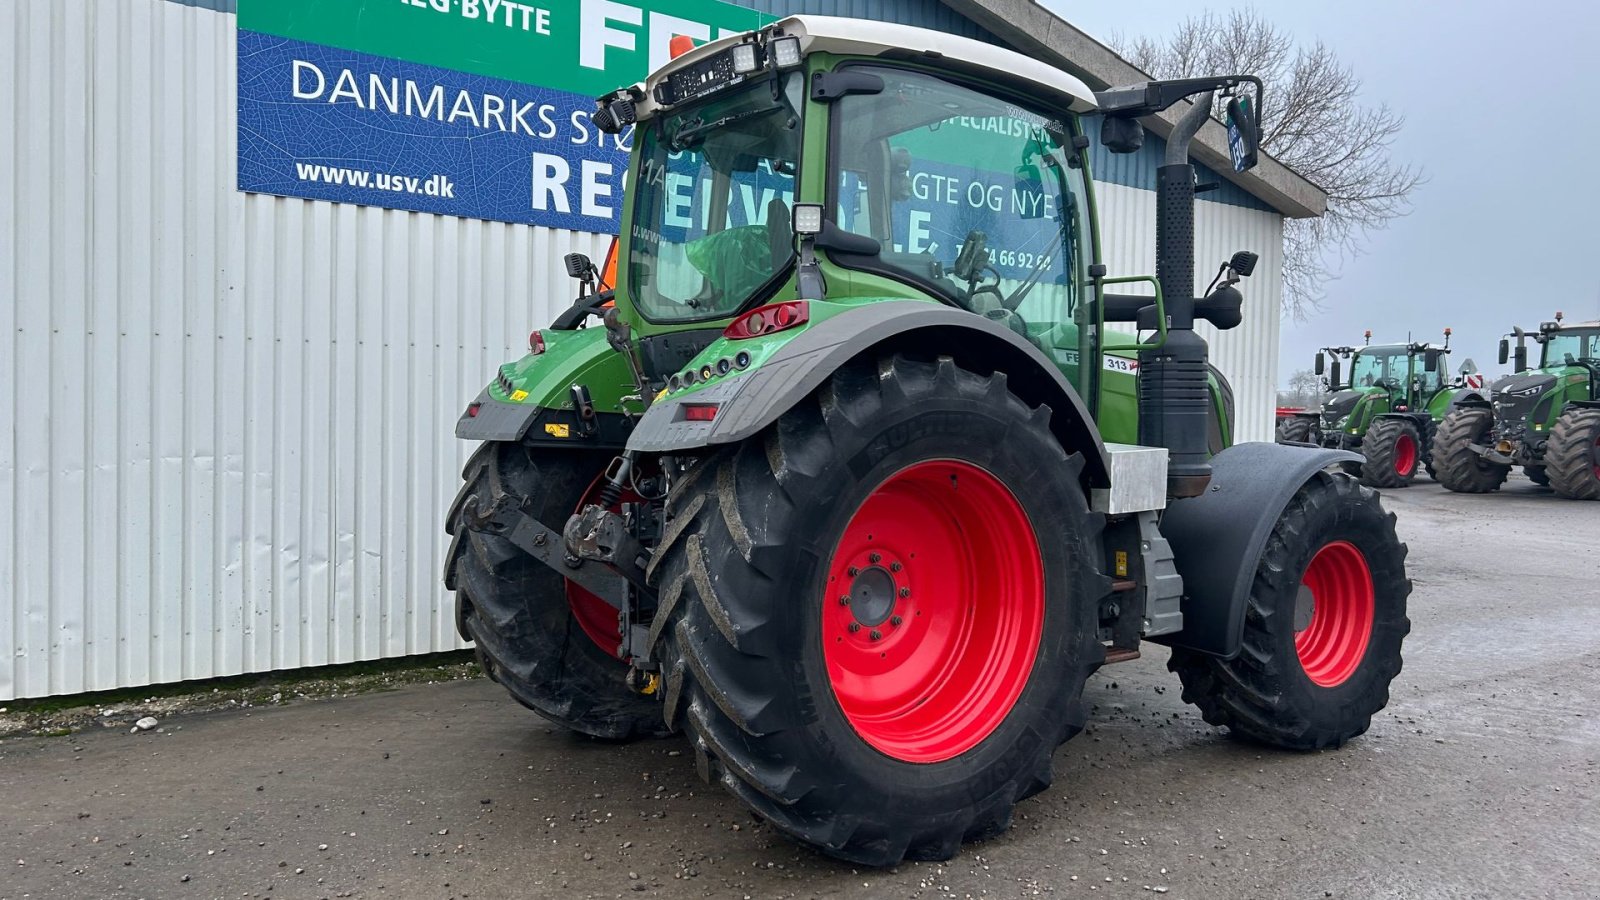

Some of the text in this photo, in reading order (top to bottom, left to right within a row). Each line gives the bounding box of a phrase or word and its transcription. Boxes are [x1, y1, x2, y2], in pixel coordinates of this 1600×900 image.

[293, 60, 557, 139] DANMARKS
[968, 182, 1003, 212] OG
[1011, 188, 1054, 219] NYE
[296, 163, 454, 198] www.usv.dk
[999, 250, 1016, 267] 66
[1018, 252, 1033, 269] 92
[1107, 359, 1127, 371] 313
